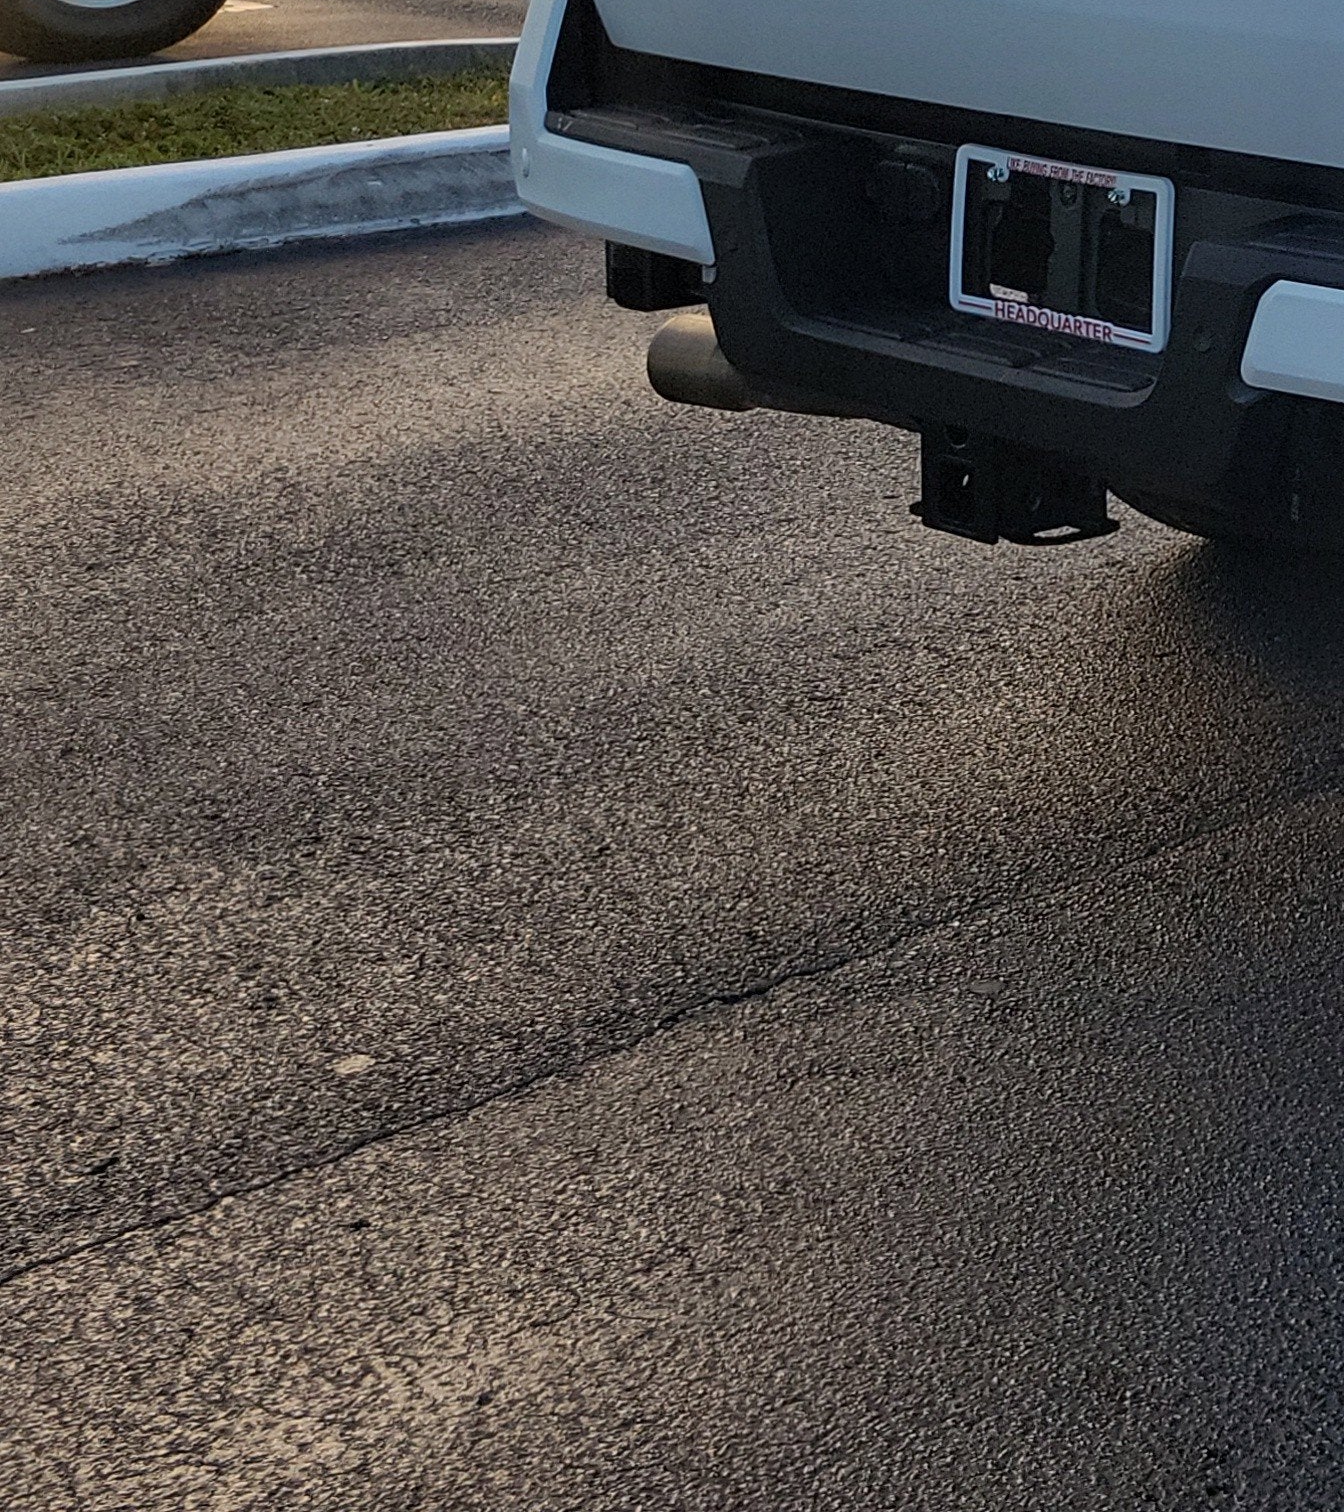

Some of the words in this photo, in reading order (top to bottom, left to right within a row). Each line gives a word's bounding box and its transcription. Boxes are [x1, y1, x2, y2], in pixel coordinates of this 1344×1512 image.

[1007, 157, 1020, 171] LIKE
[1051, 165, 1069, 179] FROM
[1072, 169, 1084, 182] THE
[994, 302, 1112, 341] HEADQUARTER
